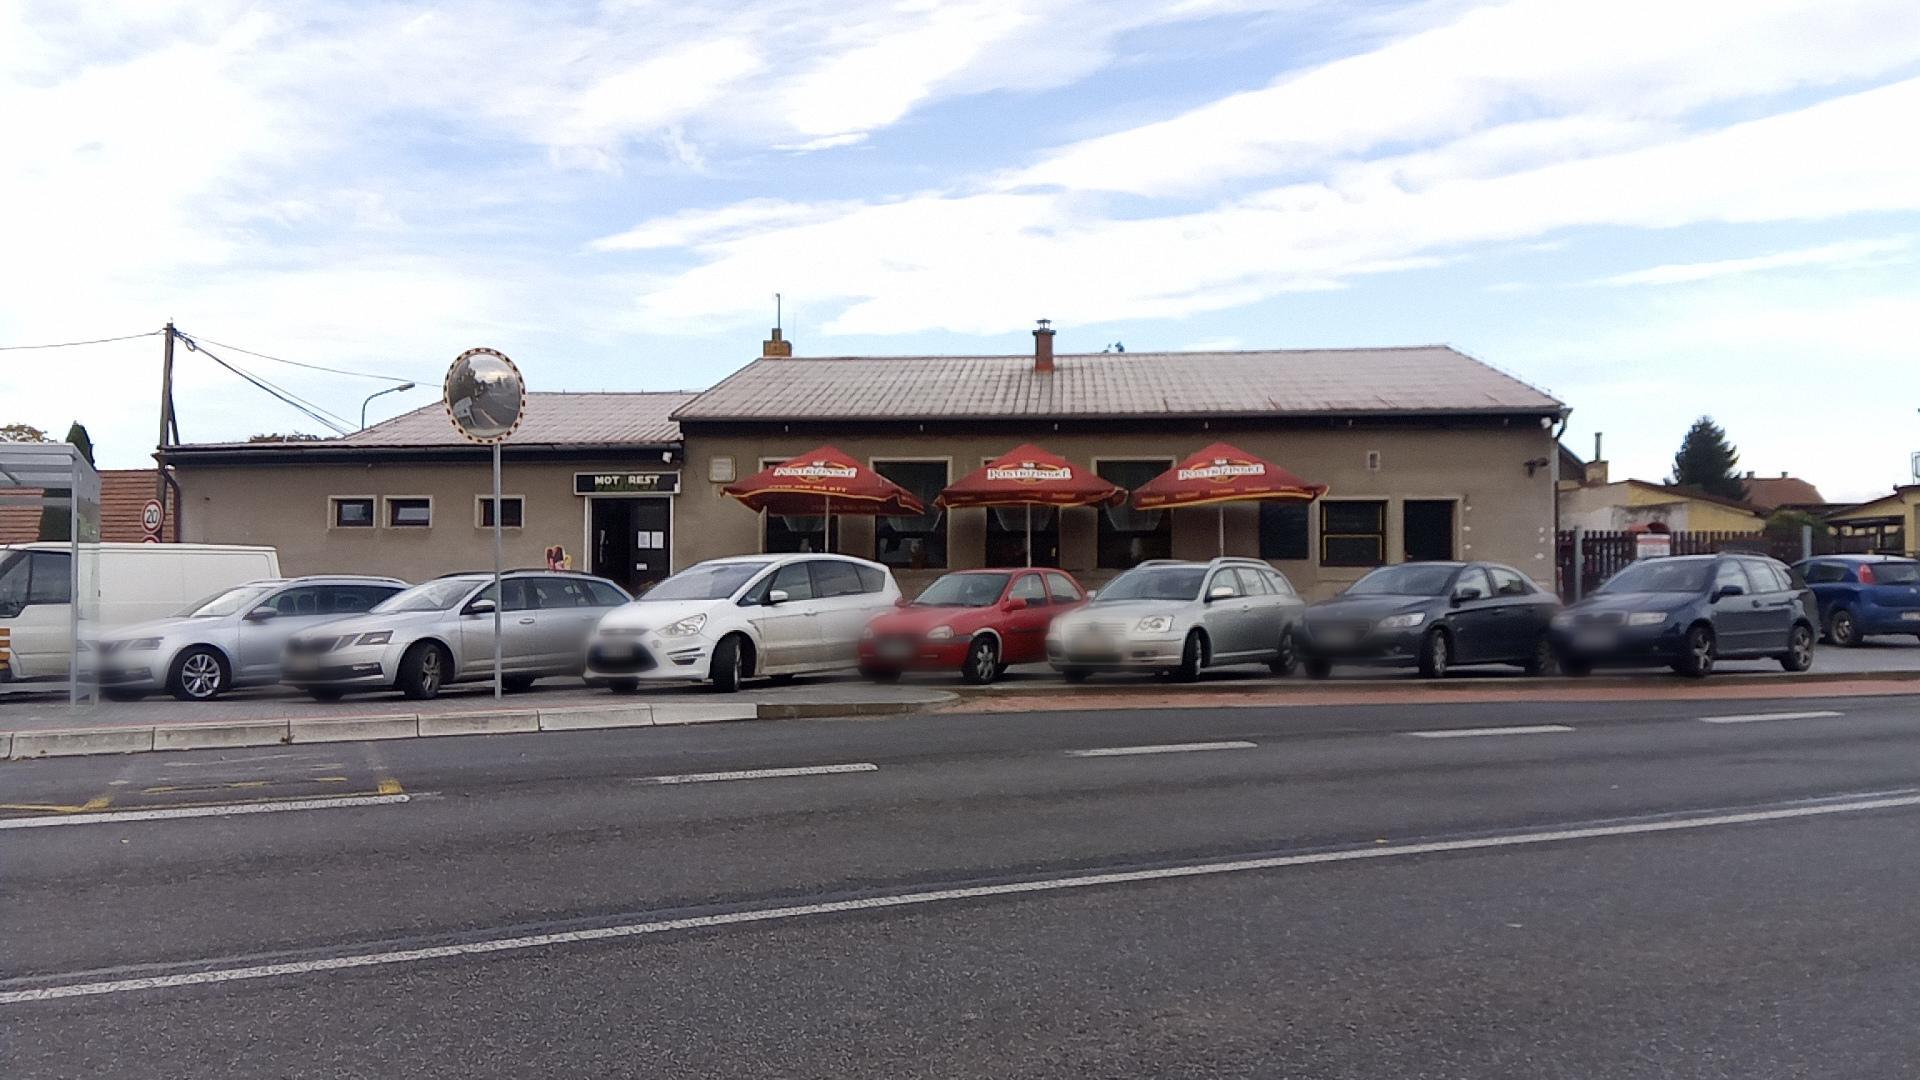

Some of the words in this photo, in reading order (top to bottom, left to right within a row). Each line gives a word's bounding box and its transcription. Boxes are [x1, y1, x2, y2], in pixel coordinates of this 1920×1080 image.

[594, 475, 620, 486] MOT
[627, 475, 660, 485] REST
[146, 509, 158, 524] 20
